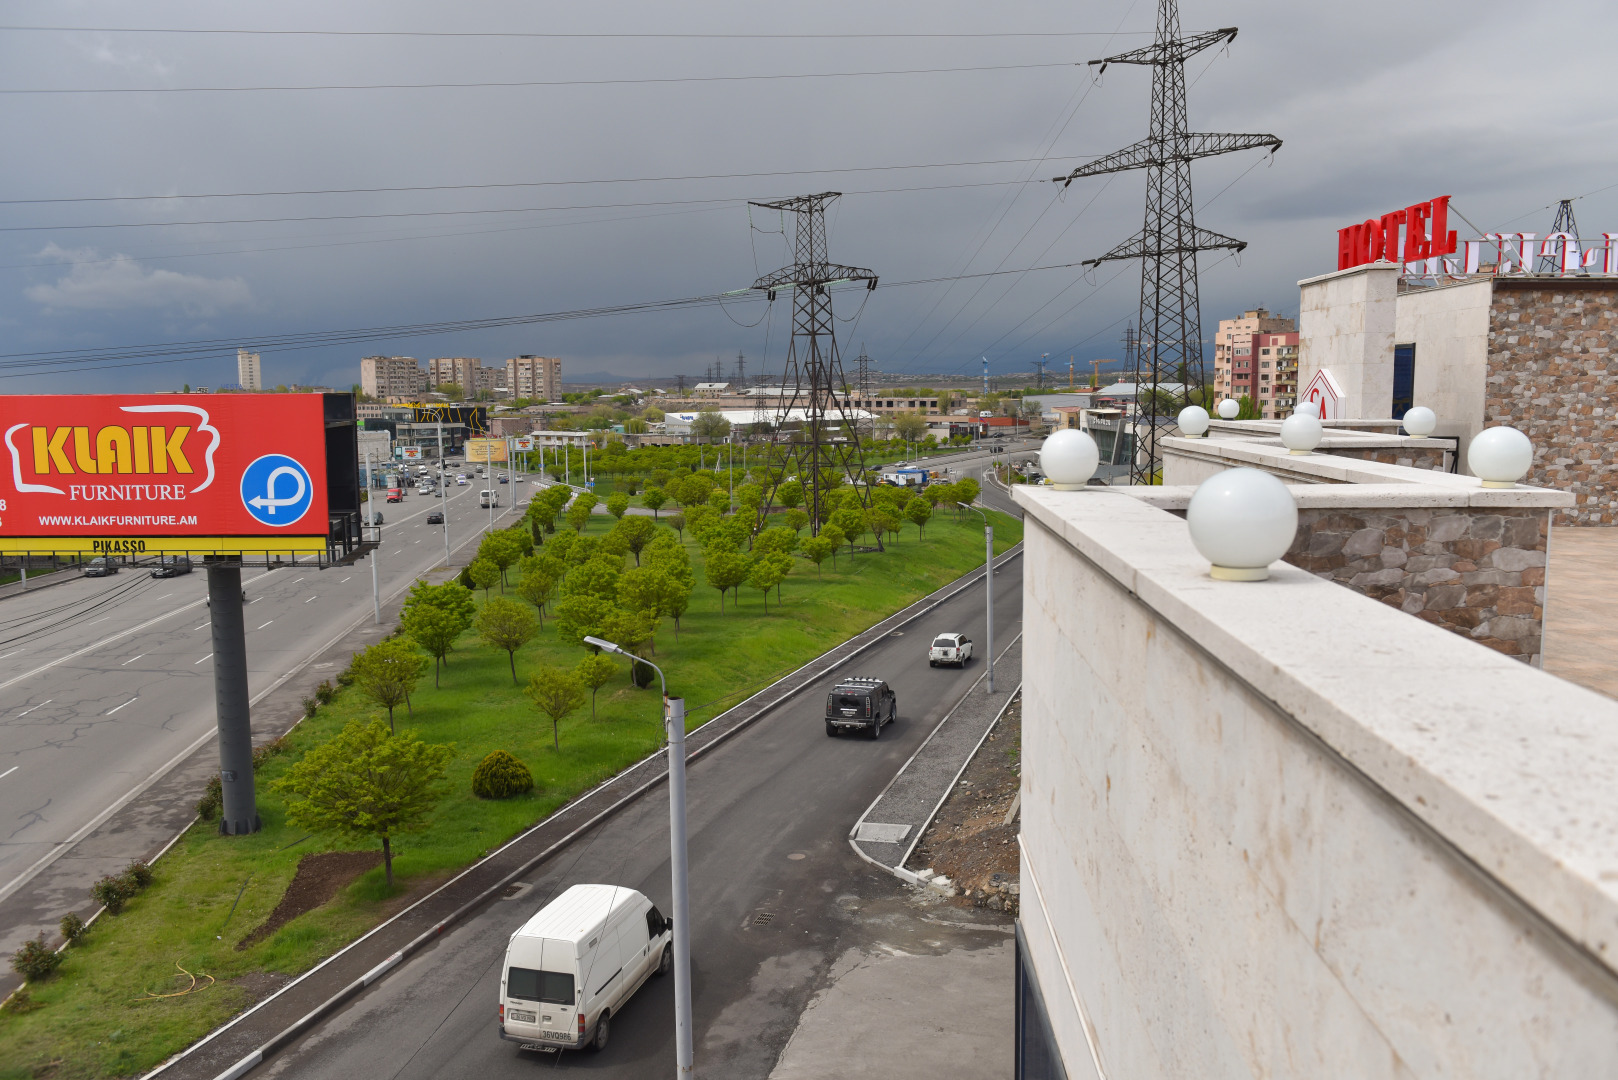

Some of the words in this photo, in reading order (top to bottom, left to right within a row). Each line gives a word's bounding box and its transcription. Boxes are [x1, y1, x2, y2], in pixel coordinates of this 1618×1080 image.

[1337, 195, 1457, 271] HOTEL
[32, 425, 195, 475] KLAIK
[70, 484, 187, 501] FURNITURE
[39, 515, 198, 526] WWW.KLAIKFURNITURE.AM
[93, 539, 146, 553] PIKASSO
